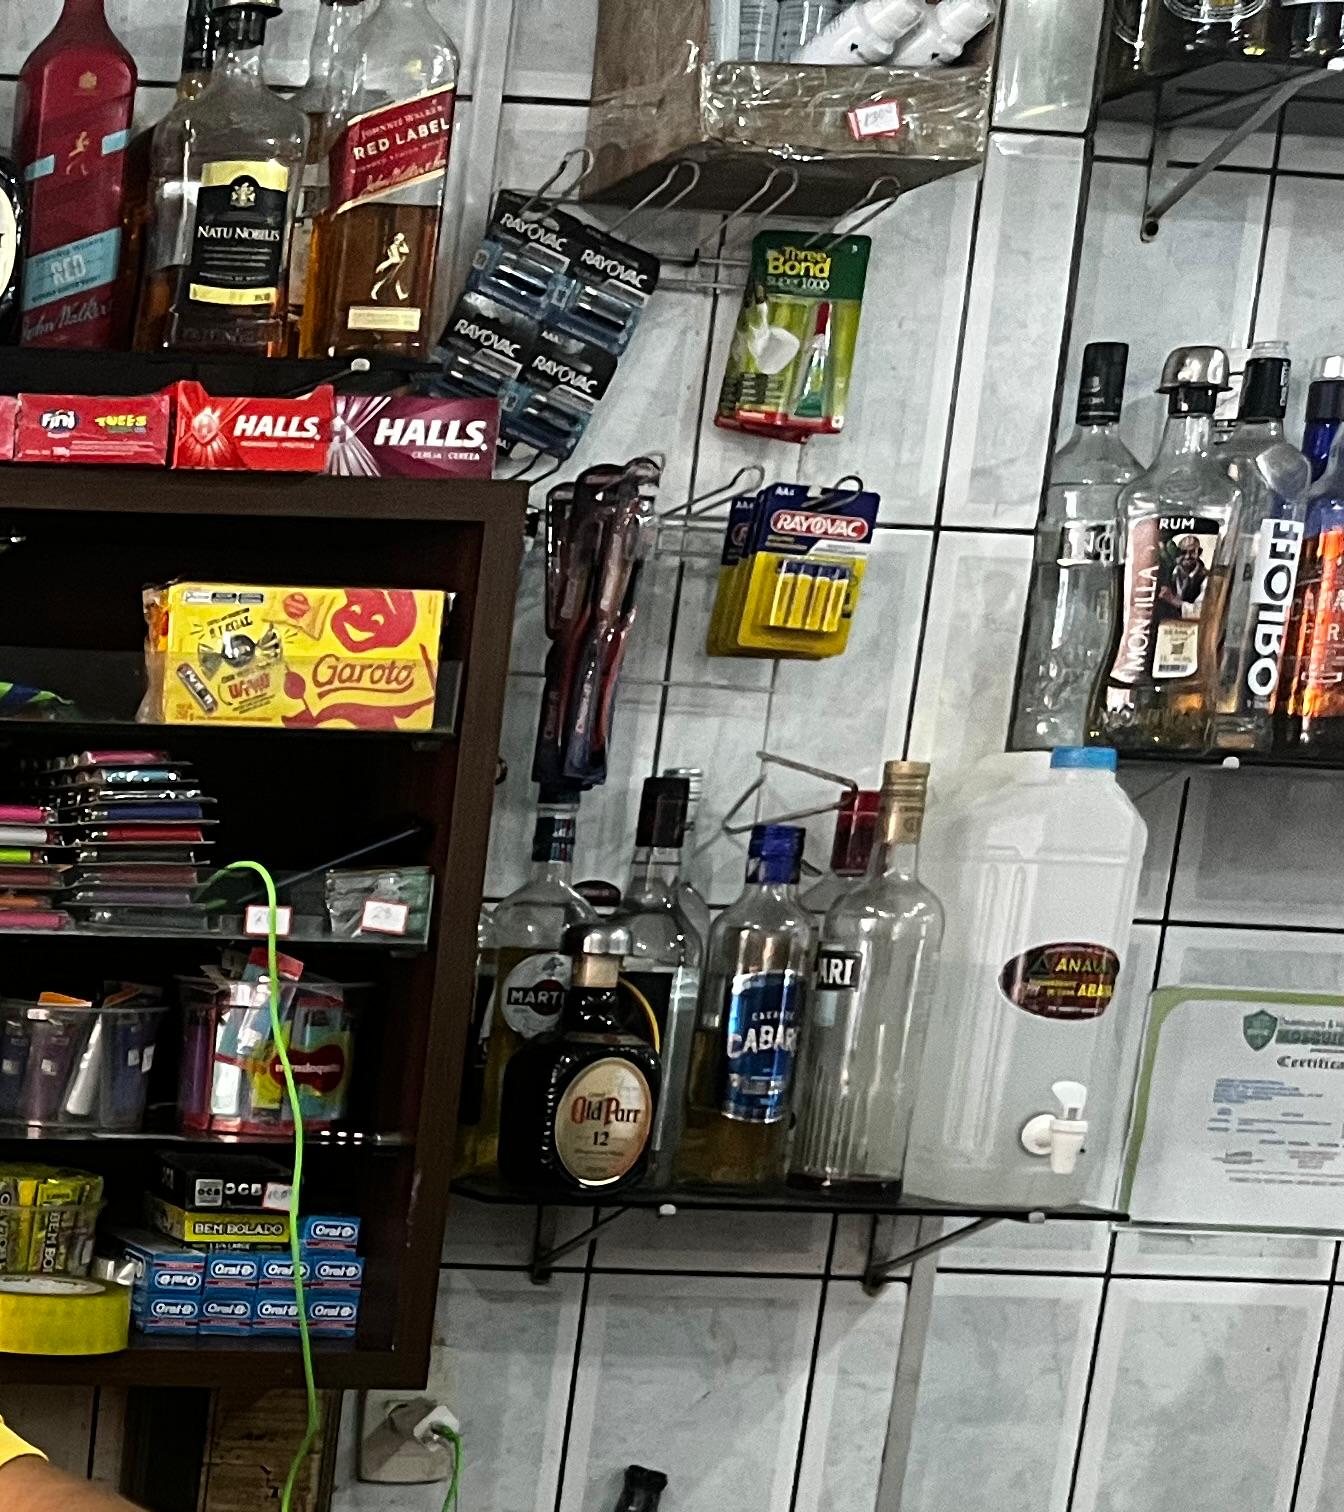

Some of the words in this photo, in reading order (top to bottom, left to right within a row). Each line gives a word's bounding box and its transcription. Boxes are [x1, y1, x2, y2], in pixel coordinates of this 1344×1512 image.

[353, 137, 391, 161] RED
[395, 117, 451, 146] LABEL
[197, 225, 233, 240] NATU
[234, 226, 281, 242] NOBILIS
[499, 211, 568, 251] RAYOVAC
[579, 247, 648, 289] RAYOVAC
[768, 251, 830, 279] Bond
[784, 246, 828, 265] Three
[801, 276, 830, 291] 1000
[453, 317, 521, 357] RAYOVAC
[531, 354, 599, 394] RAYOVAC
[776, 513, 863, 538] RAYOVAC
[1158, 517, 1195, 531] RUM
[1125, 564, 1161, 674] MONILLA
[312, 653, 417, 696] Garoto
[570, 1095, 602, 1124] Old
[602, 1096, 642, 1127] Parr
[592, 1130, 610, 1147] 12
[224, 1182, 262, 1196] OCB
[226, 1223, 283, 1236] BOLADO
